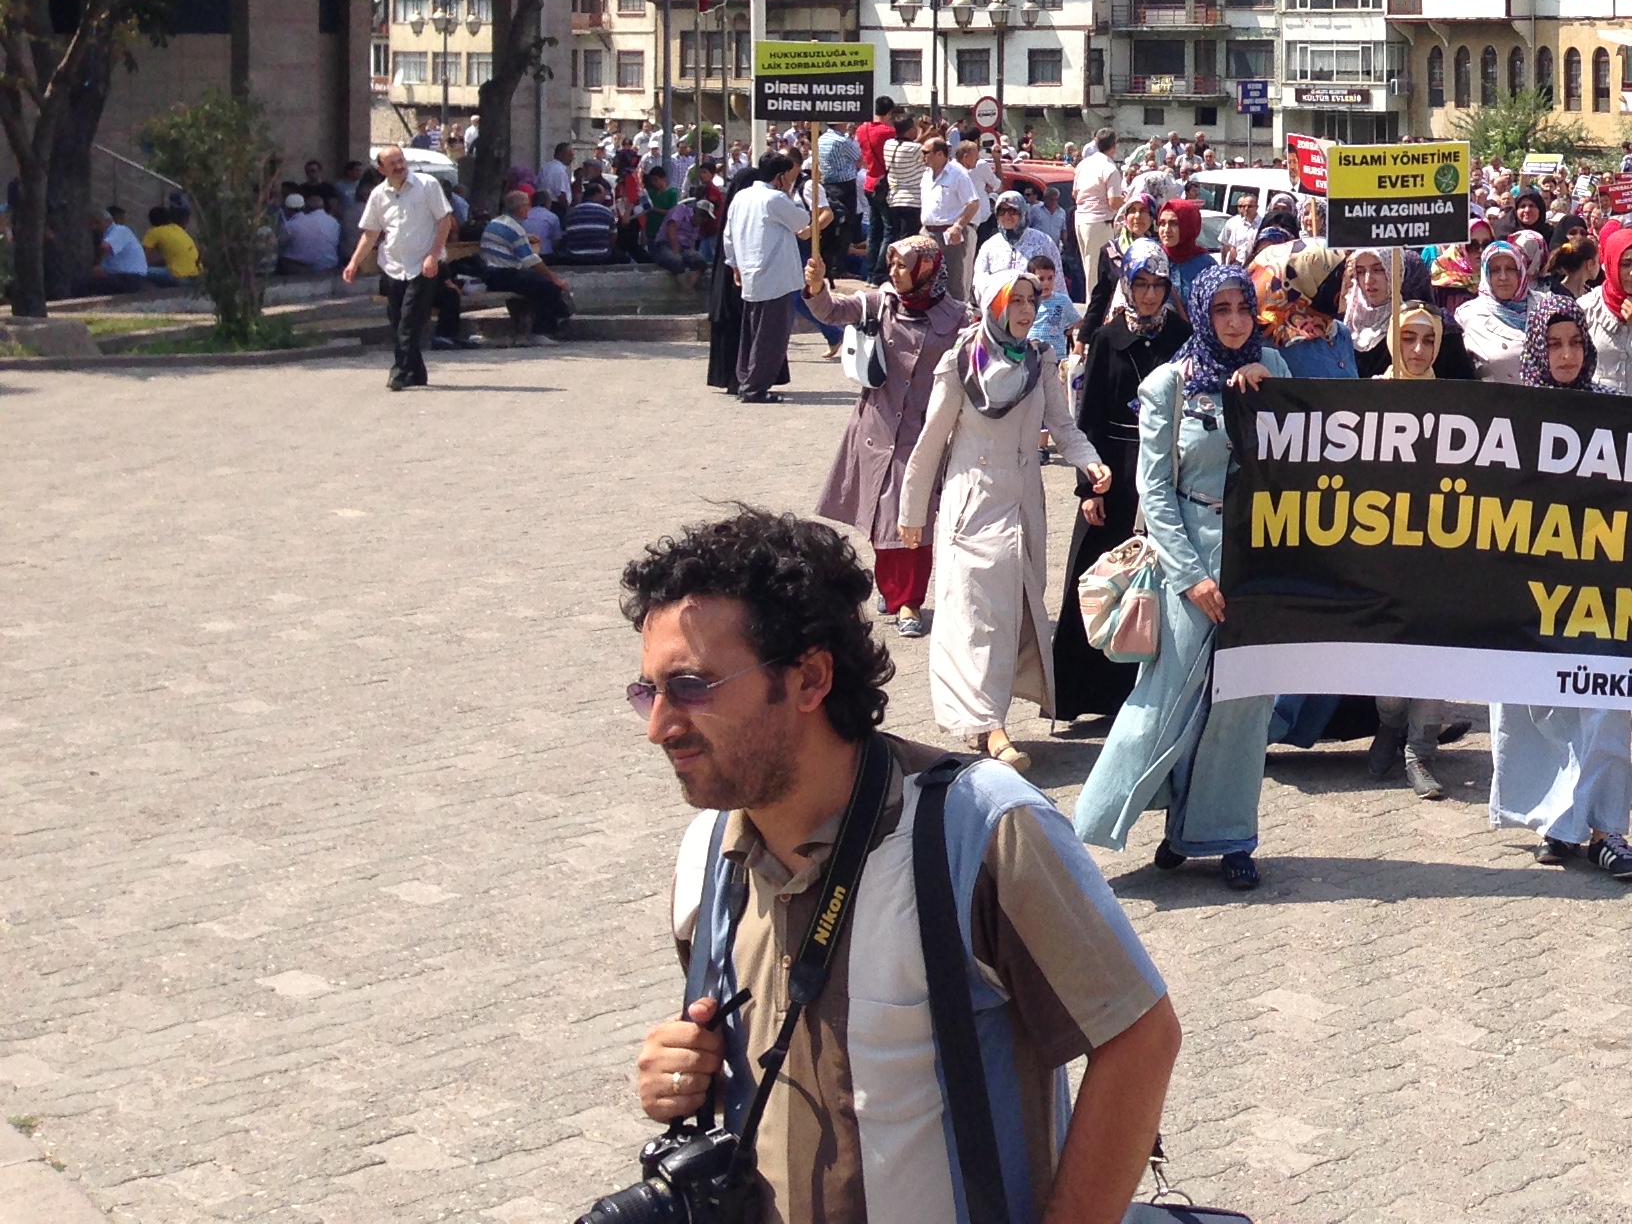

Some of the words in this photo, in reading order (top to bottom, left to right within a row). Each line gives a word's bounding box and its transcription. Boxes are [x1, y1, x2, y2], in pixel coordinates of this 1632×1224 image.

[762, 61, 782, 70] LAİK
[785, 60, 838, 69] ZORBALIĞA
[840, 59, 868, 68] KARŞI
[764, 80, 809, 94] DİREN
[812, 82, 864, 95] MURSİ!
[767, 97, 812, 110] DİREN
[815, 100, 860, 111] MISIR!
[1339, 151, 1387, 167] İSLAMİ
[1391, 149, 1460, 165] YÖNETİME
[1377, 174, 1424, 189] EVET!
[1345, 202, 1377, 217] LAİK
[1380, 200, 1454, 217] AZGINLIĞA
[1371, 222, 1430, 239] HAYIR!
[1256, 411, 1521, 469] MISIR'DA
[1251, 475, 1629, 562] MÜSLÜMAN
[813, 885, 846, 946] Nikon
